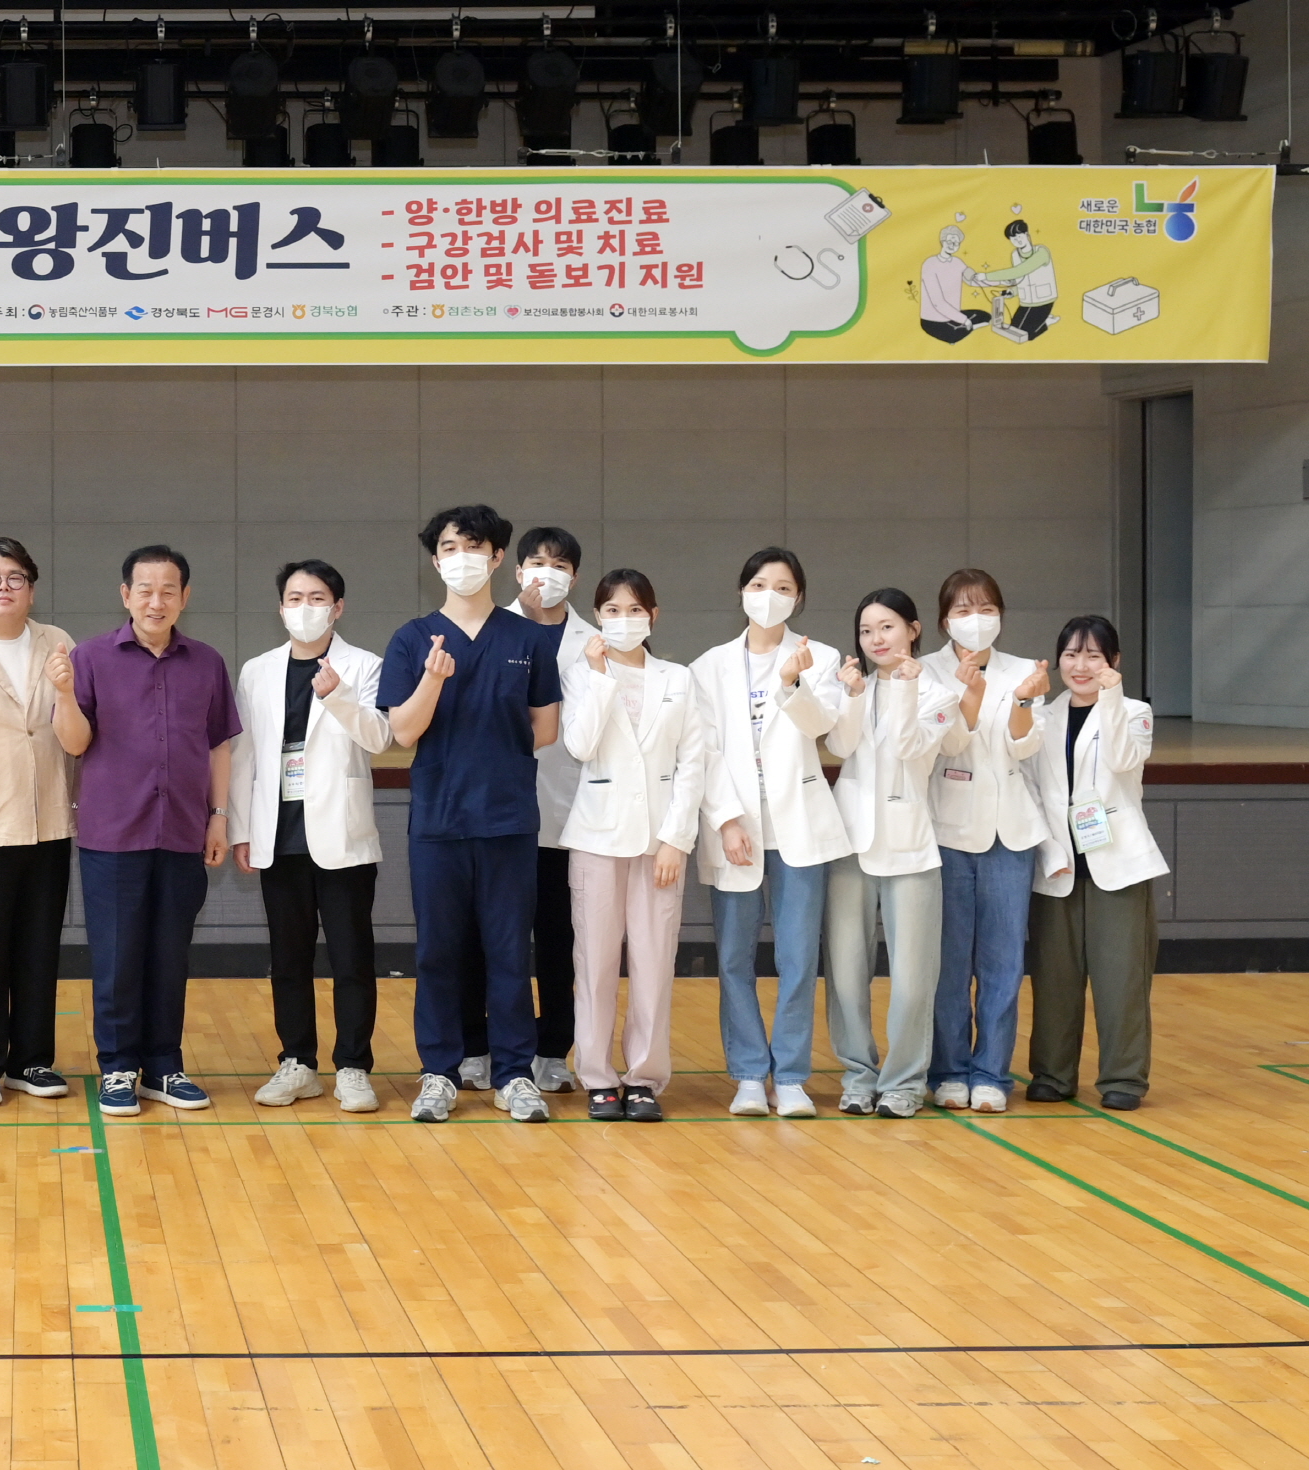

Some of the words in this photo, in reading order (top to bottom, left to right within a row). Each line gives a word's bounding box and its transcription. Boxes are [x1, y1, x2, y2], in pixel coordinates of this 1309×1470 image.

[405, 197, 522, 227] 양·한방
[533, 197, 670, 226] 의료진료
[1080, 200, 1118, 213] 새로운
[1079, 219, 1129, 234] 대한민국
[1133, 219, 1157, 234] 농협
[406, 230, 543, 259] 구강검사
[555, 229, 584, 258] 및
[597, 230, 664, 257] 치료
[406, 262, 473, 290] 검안
[484, 262, 513, 290] 및
[527, 262, 626, 290] 돋보기
[639, 262, 704, 290] 지원
[49, 307, 118, 318] 농림축산식품부
[151, 307, 200, 318] 경상북도
[251, 306, 284, 318] 문경시
[310, 305, 358, 318] 경북농협
[448, 306, 496, 317] 점촌농협
[524, 307, 604, 318] 보건의료통합봉사회
[628, 307, 698, 317] 대한의료봉사회
